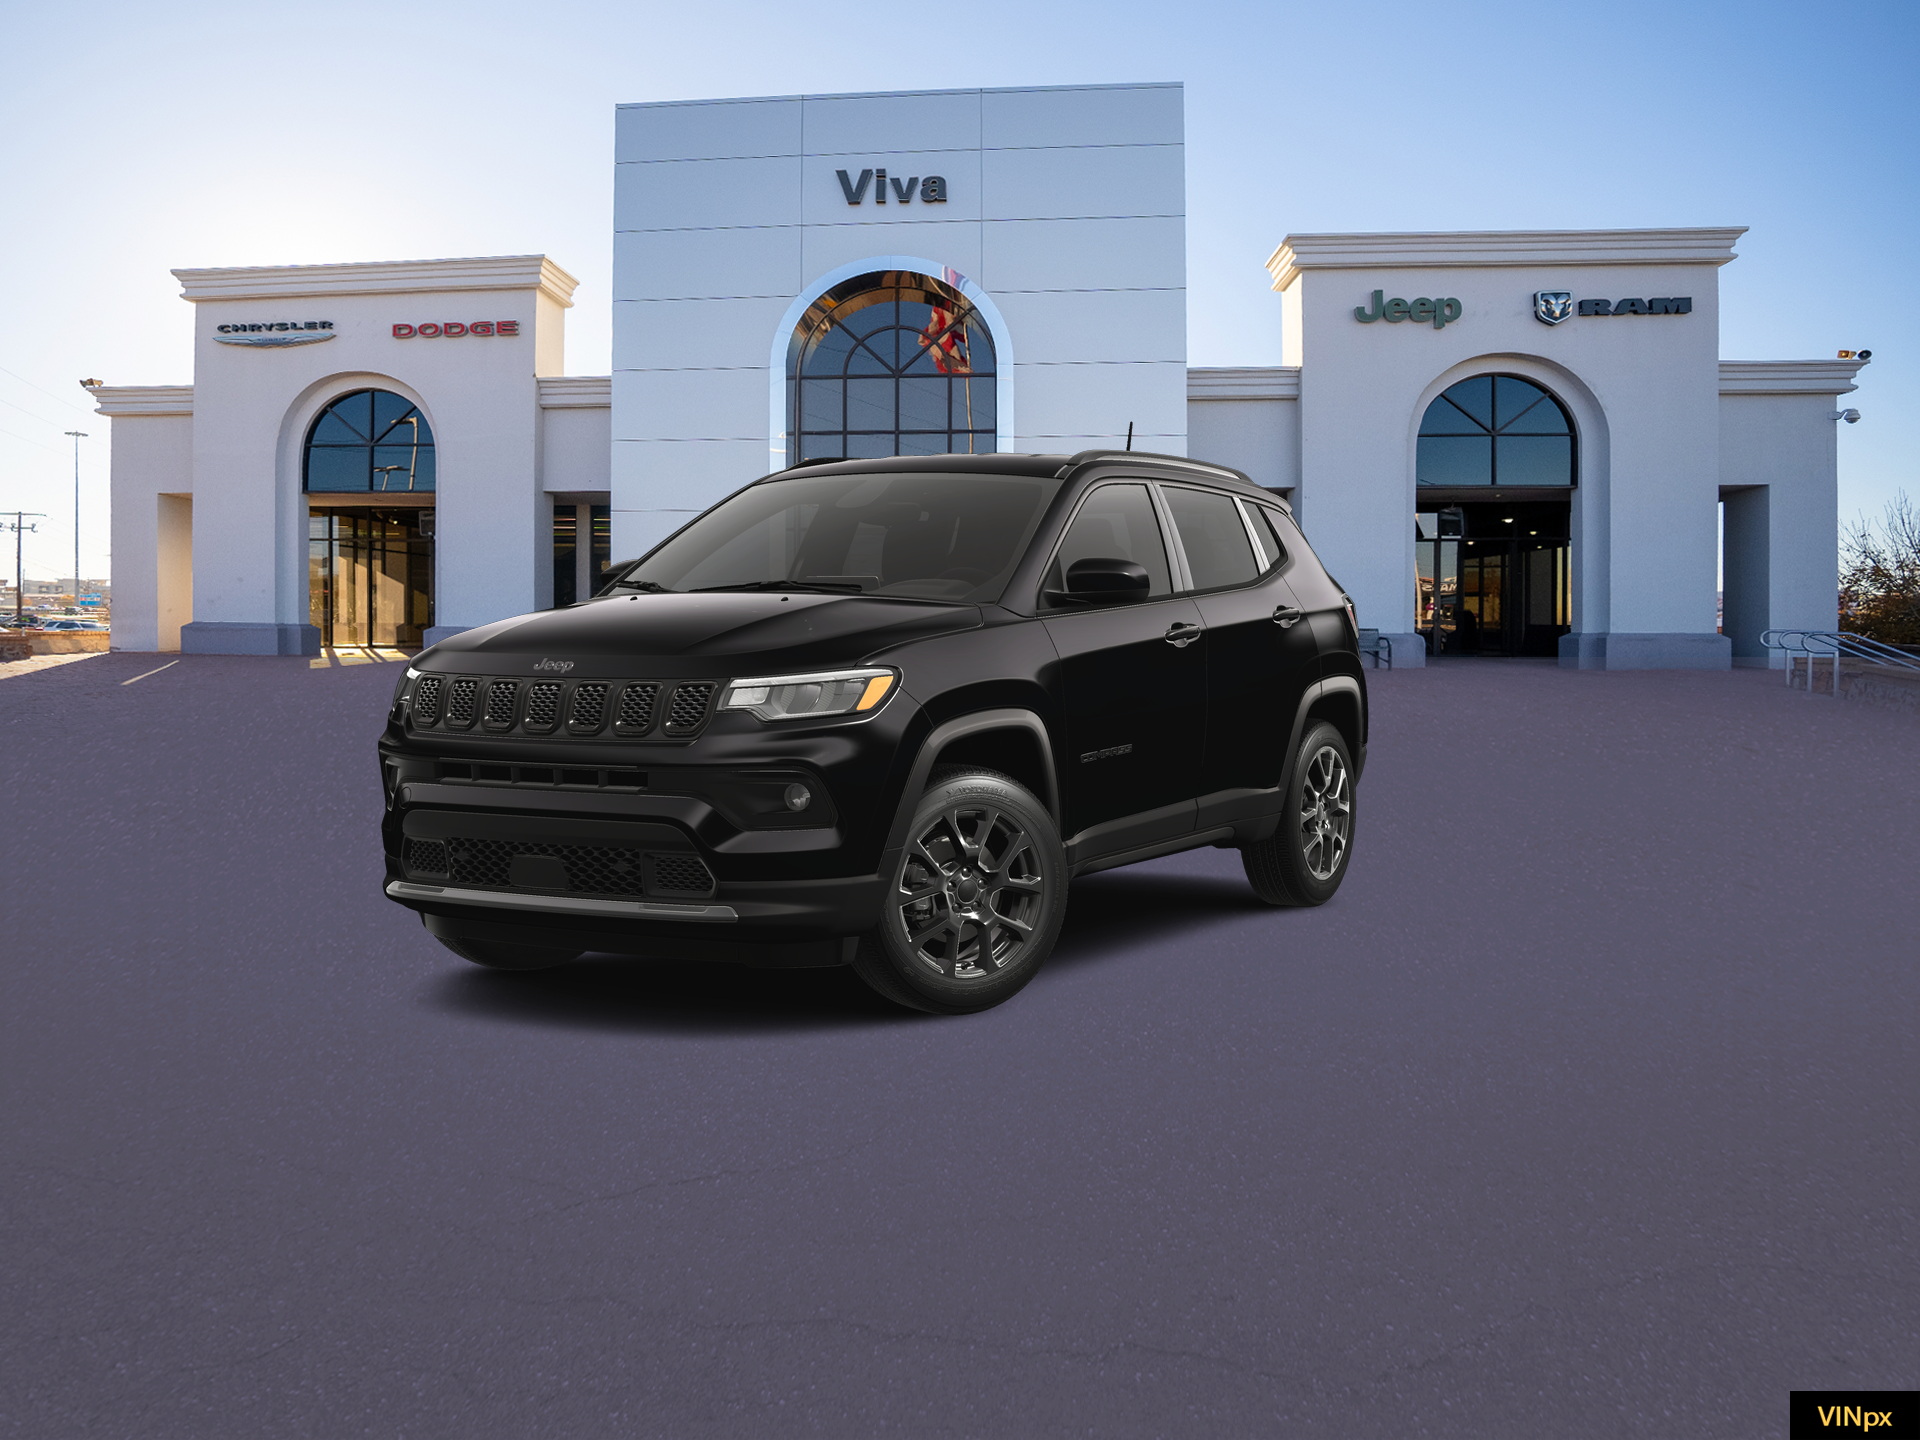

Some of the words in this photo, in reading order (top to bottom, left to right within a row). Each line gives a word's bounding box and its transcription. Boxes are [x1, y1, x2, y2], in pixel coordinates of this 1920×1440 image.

[835, 168, 947, 205] Viva
[1354, 289, 1462, 329] Jeep
[1578, 297, 1692, 316] RAM
[217, 320, 334, 333] CHRYSLER
[392, 320, 519, 338] DODGE
[533, 657, 575, 674] Jeep
